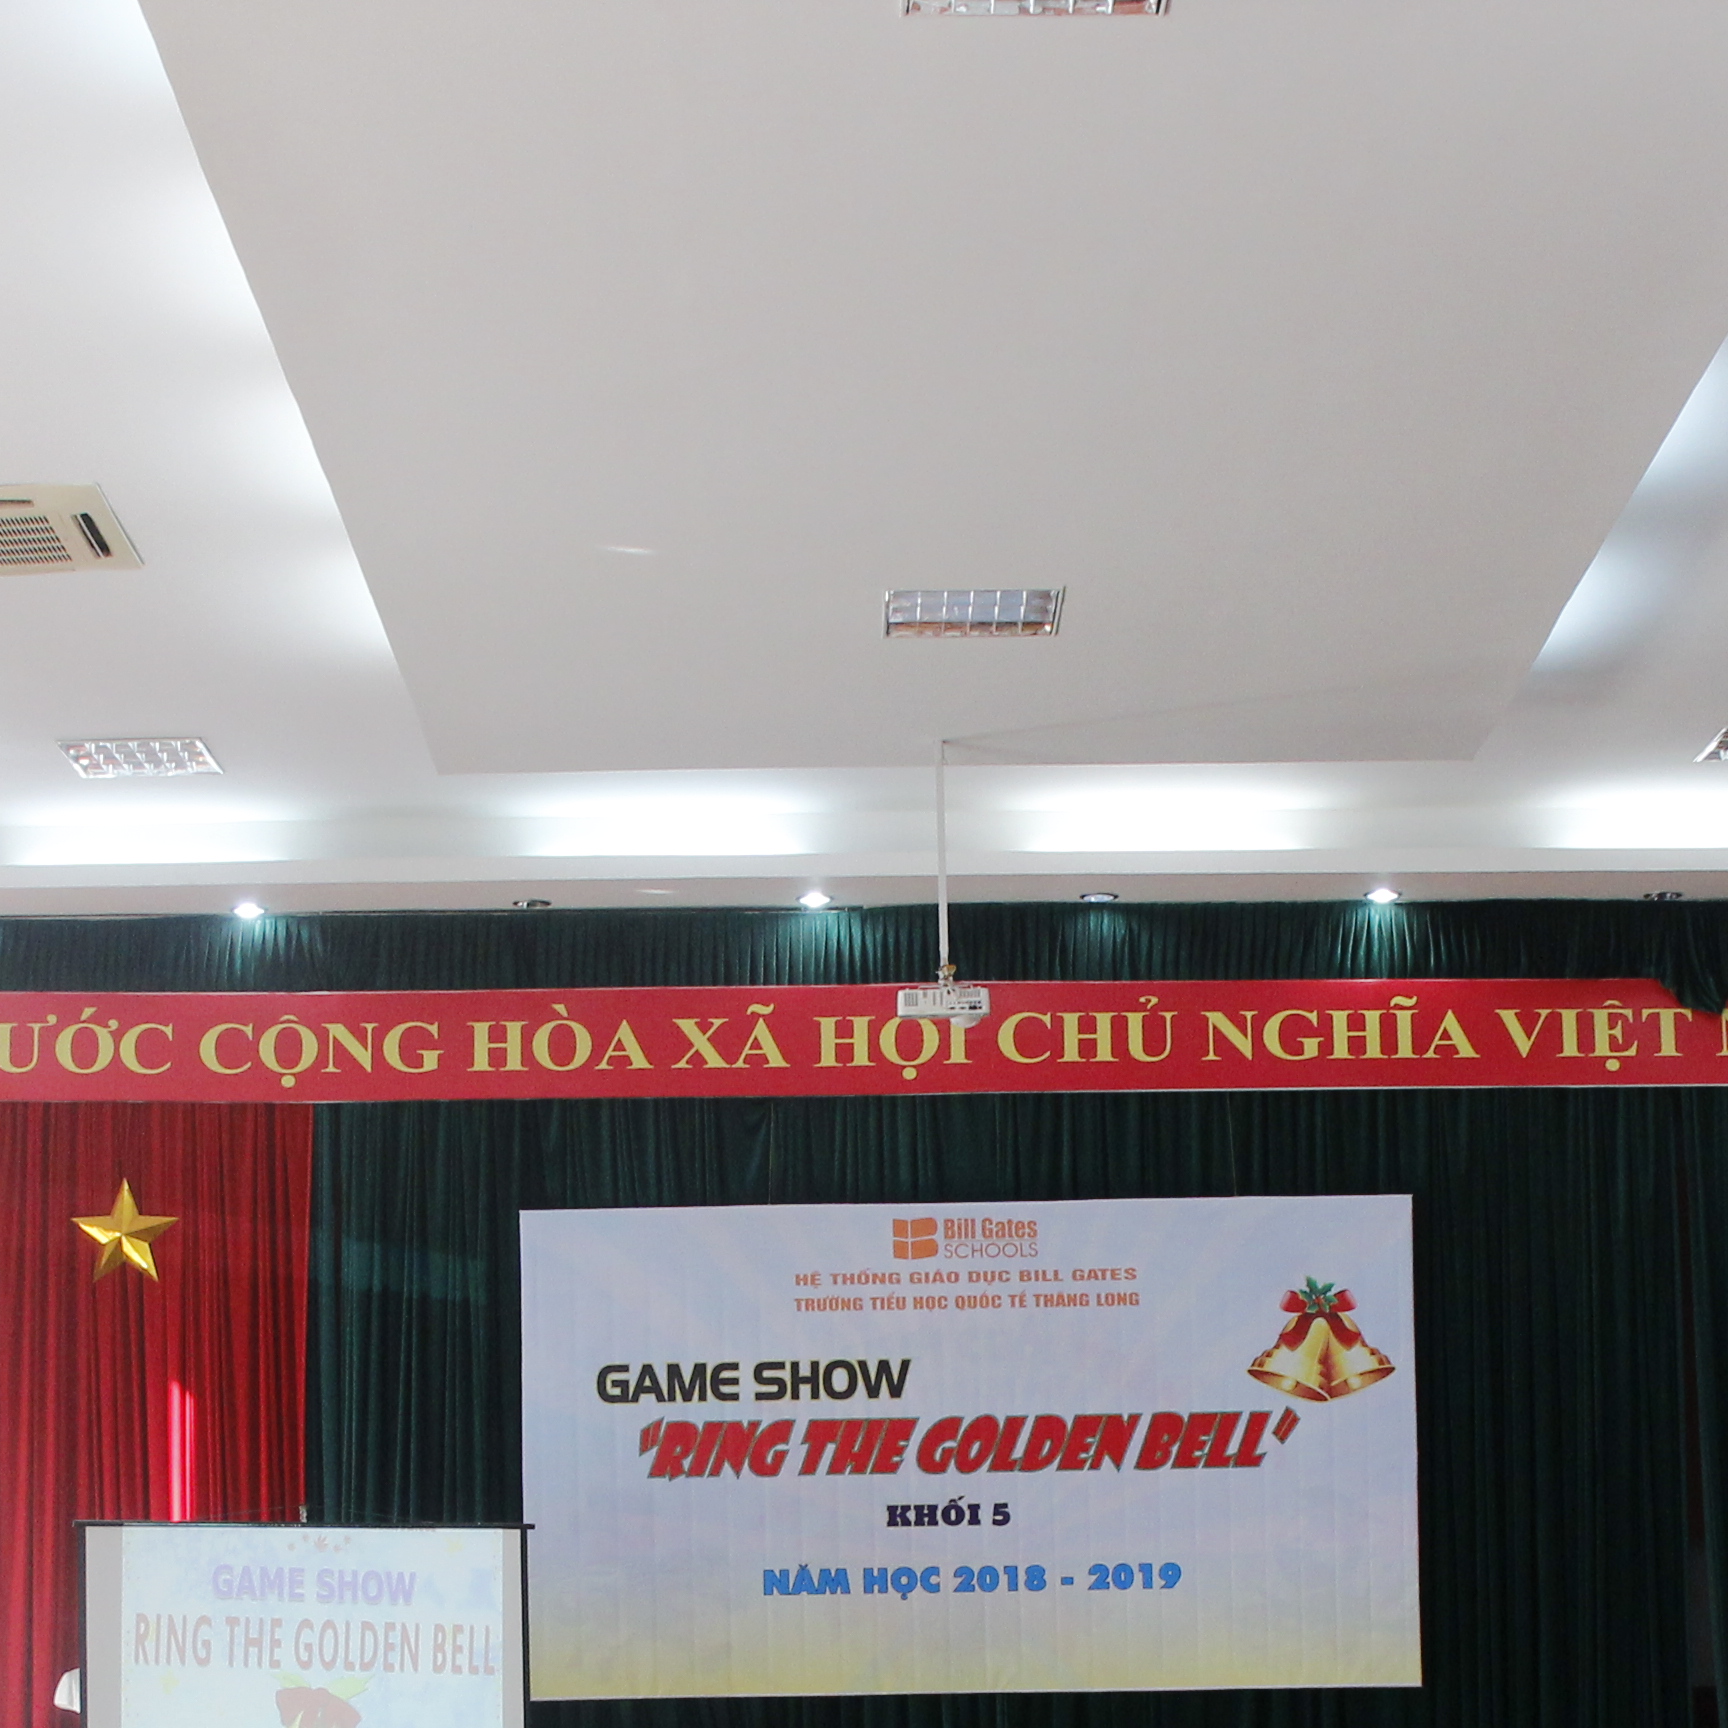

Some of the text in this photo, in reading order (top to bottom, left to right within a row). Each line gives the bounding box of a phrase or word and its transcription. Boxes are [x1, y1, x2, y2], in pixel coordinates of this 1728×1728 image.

[198, 1013, 443, 1088] CỘNG
[467, 1003, 653, 1072] HÒA
[674, 1003, 790, 1069] XÃ
[996, 996, 1176, 1064] CHỦ
[1201, 995, 1479, 1062] NGHĨA
[1495, 1000, 1693, 1072] VIỆT
[943, 1217, 1039, 1240] Bill Gates
[944, 1241, 1039, 1260] SCHOOLS
[909, 1267, 960, 1284] GIÁO
[1018, 1269, 1063, 1283] BILL
[1071, 1267, 1138, 1282] GATES
[912, 1296, 948, 1311] HỌC
[1096, 1292, 1140, 1307] LONG
[596, 1358, 912, 1404] GAME SHOW
[798, 1417, 920, 1476] THE
[915, 1411, 1132, 1474] GOLDEN
[886, 1494, 1011, 1528] KHỐI 5
[212, 1563, 417, 1605] GAME SHOW
[763, 1563, 850, 1595] NĂM
[863, 1566, 941, 1599] HỌC
[954, 1564, 1047, 1593] 2018
[1088, 1562, 1183, 1591] 2019
[133, 1612, 495, 1675] RING THE GOLDEN BELL
